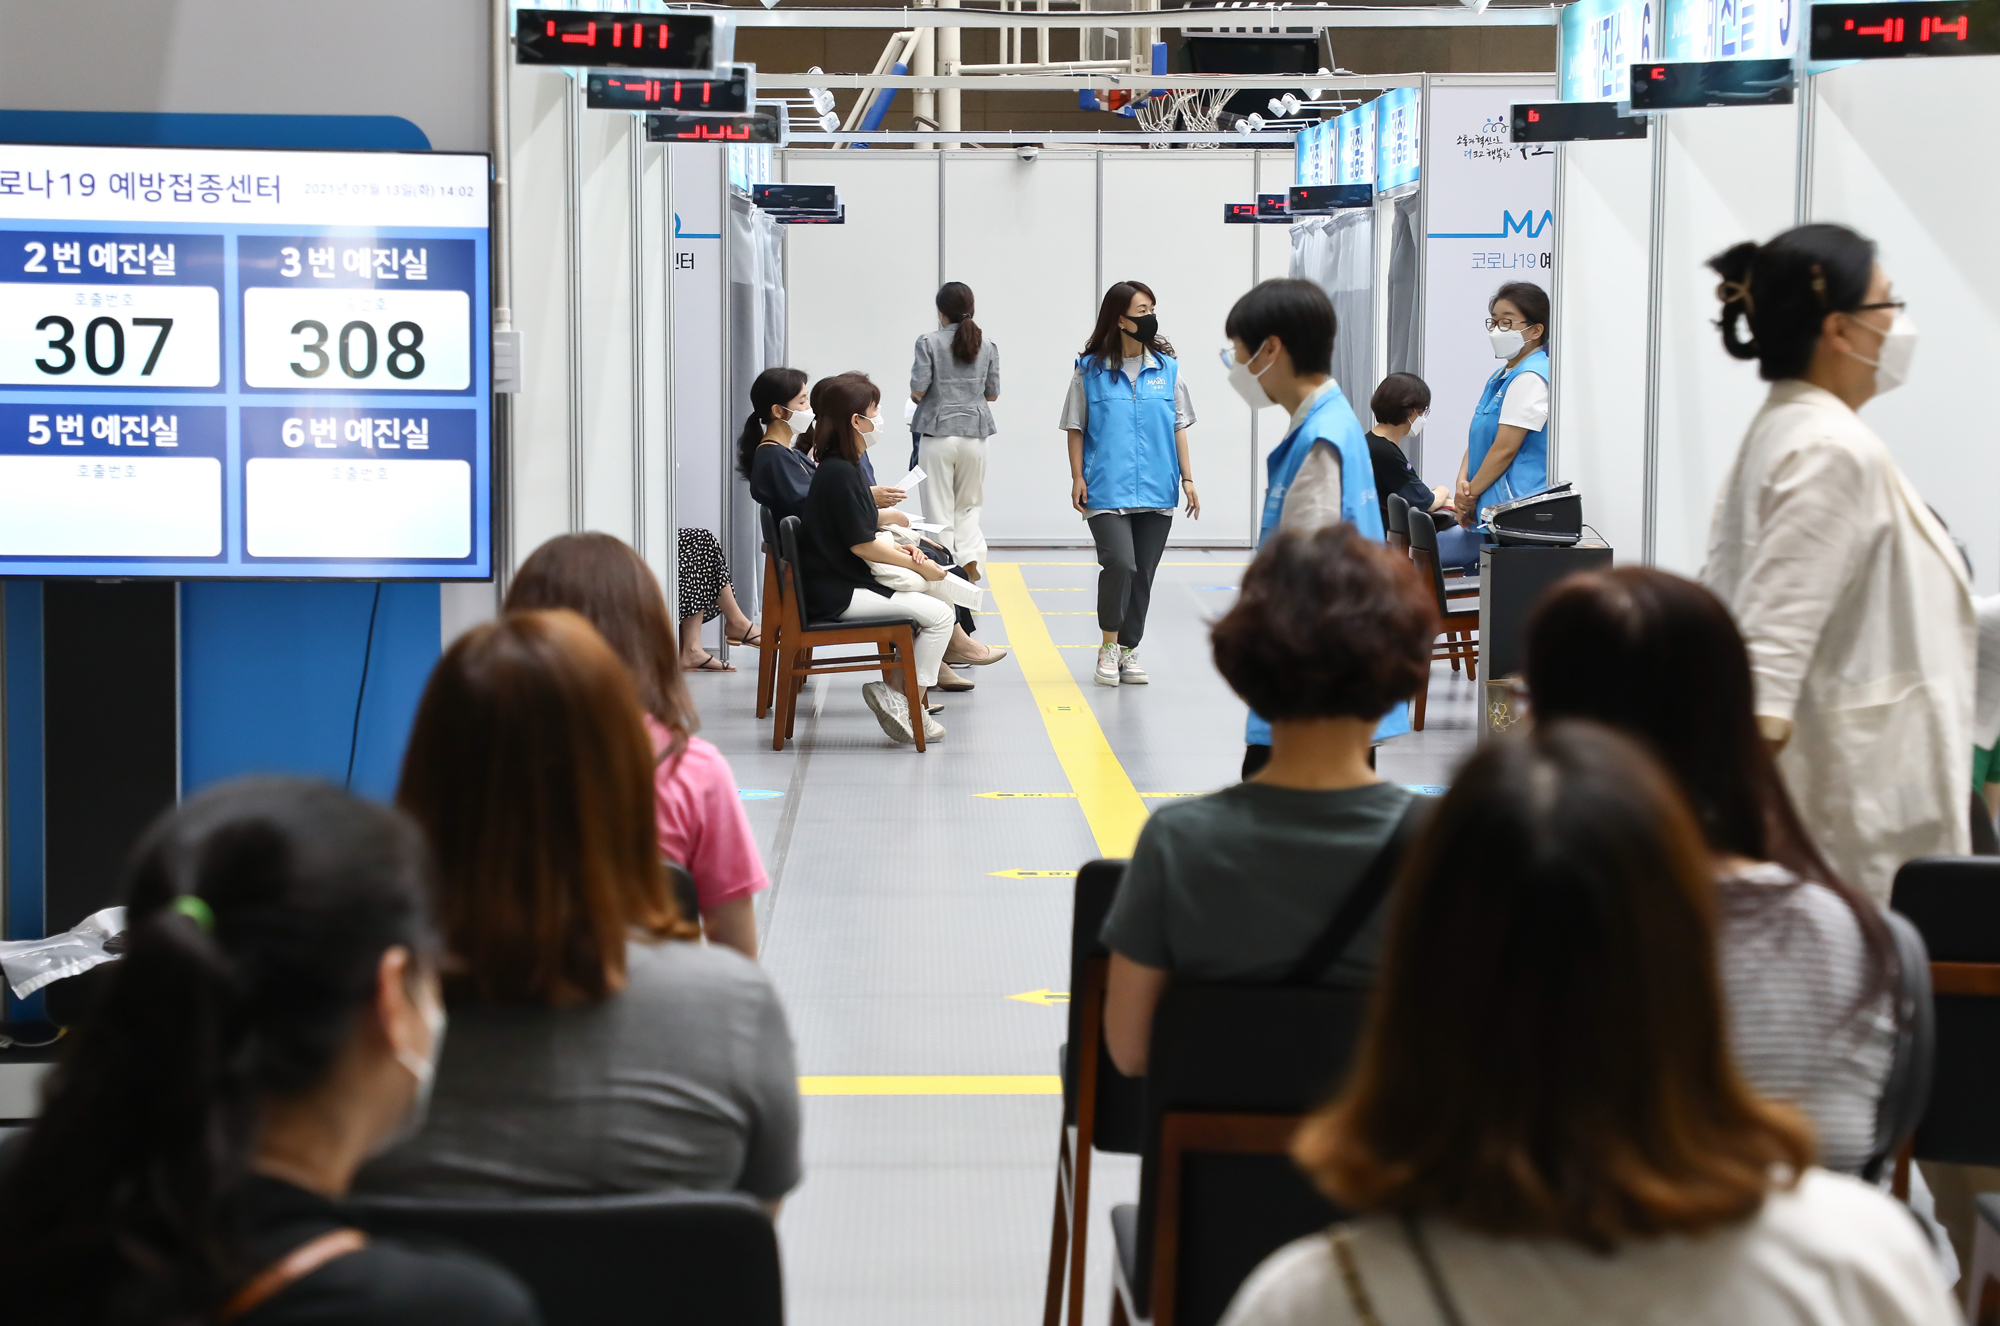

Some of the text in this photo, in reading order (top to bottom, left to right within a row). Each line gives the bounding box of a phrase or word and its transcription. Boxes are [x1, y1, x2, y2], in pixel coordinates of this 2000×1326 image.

[109, 171, 281, 204] 예방접종센터
[88, 242, 176, 276] 예진실
[342, 247, 428, 280] 예진실
[1471, 252, 1536, 269] 코로나19
[34, 315, 174, 376] 307
[289, 319, 426, 381] 308
[91, 414, 178, 447] 예진실
[344, 418, 430, 450] 예진실
